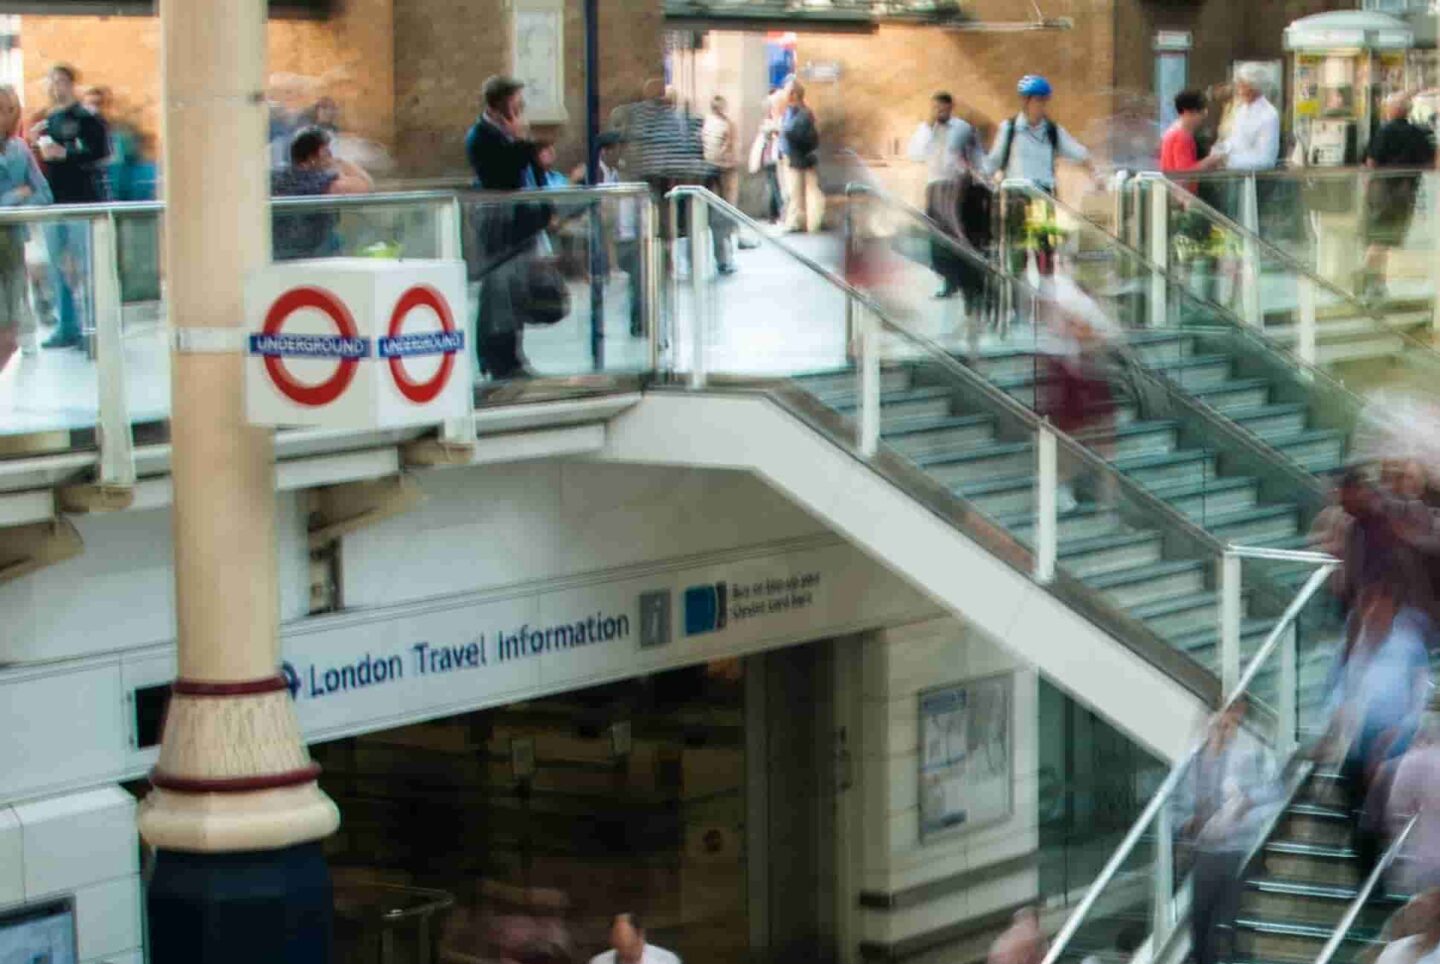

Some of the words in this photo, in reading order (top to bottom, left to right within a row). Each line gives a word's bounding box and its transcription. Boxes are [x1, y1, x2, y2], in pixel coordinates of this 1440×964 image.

[256, 334, 364, 354] UNDERGROUND
[382, 332, 462, 354] UNDERGROUND
[310, 652, 403, 698] London
[413, 636, 487, 674] Travel
[498, 612, 630, 662] Information
